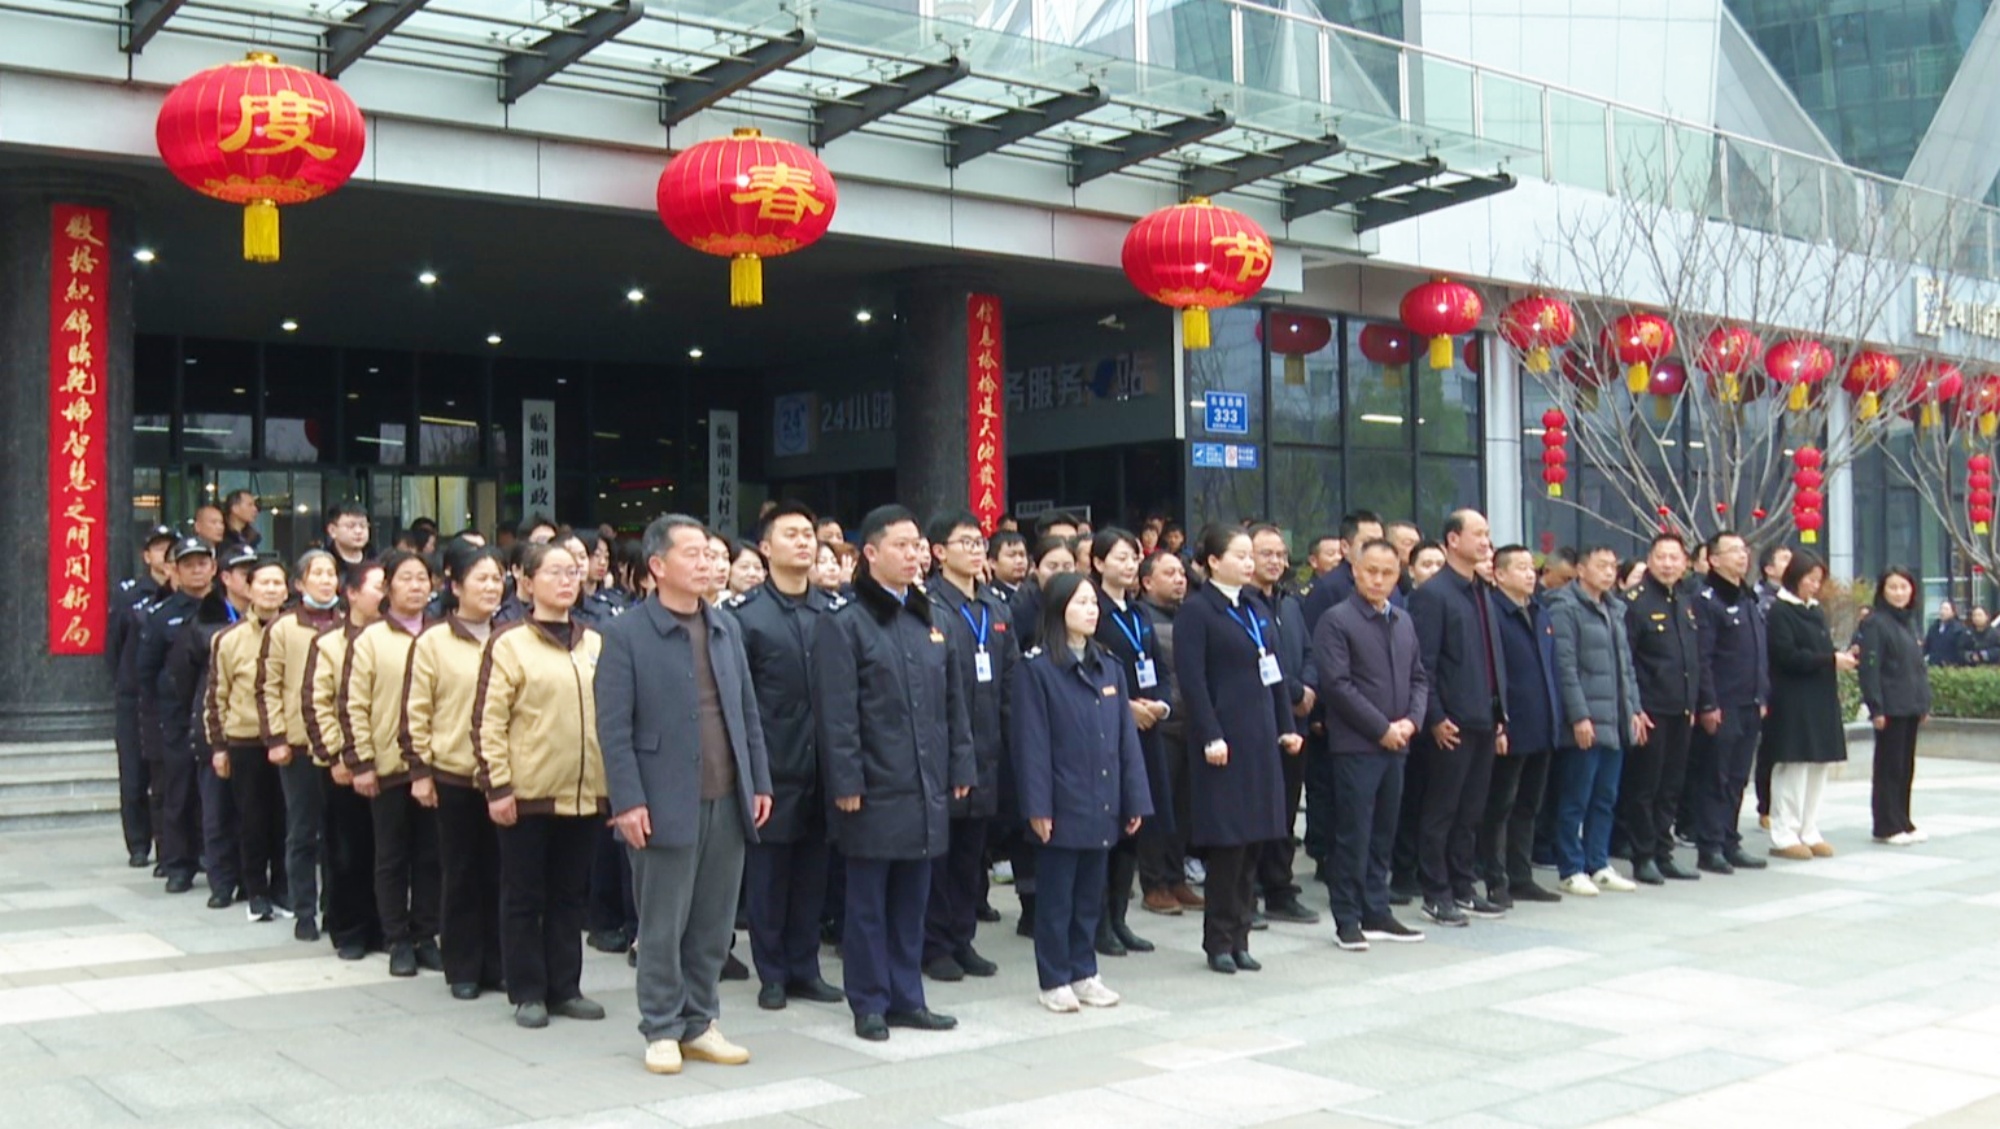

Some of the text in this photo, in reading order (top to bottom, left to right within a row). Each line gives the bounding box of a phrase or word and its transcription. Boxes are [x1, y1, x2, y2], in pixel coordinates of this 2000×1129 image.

[218, 90, 337, 160] 度
[730, 162, 825, 224] 春
[1211, 231, 1272, 283] 节
[1214, 408, 1237, 423] 333
[530, 412, 548, 518] 临湘市政
